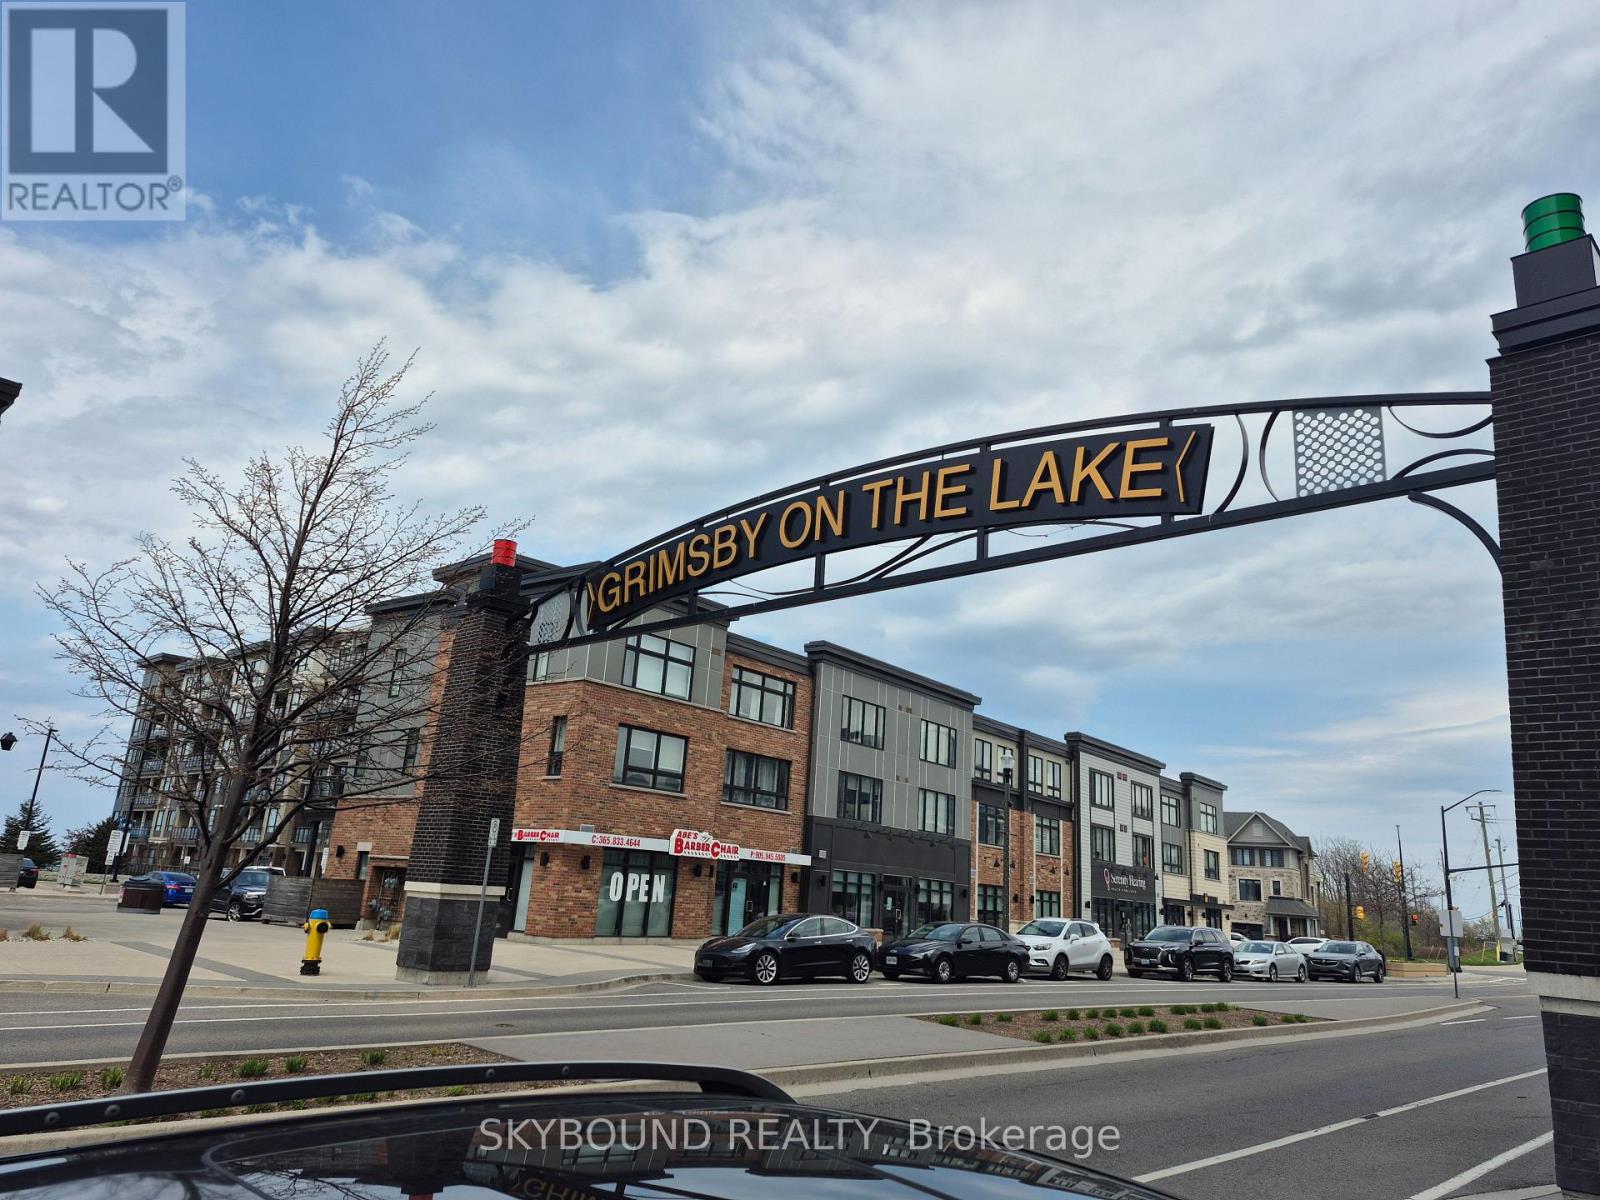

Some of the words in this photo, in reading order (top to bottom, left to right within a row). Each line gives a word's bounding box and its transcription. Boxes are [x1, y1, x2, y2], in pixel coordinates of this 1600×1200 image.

[596, 512, 769, 614] GRIMSBY
[778, 489, 846, 550] ON
[862, 463, 971, 530] THE
[989, 437, 1169, 512] LAKE
[676, 830, 699, 840] ABE'S
[609, 871, 666, 903] OPEN
[1129, 874, 1147, 891] Hearing
